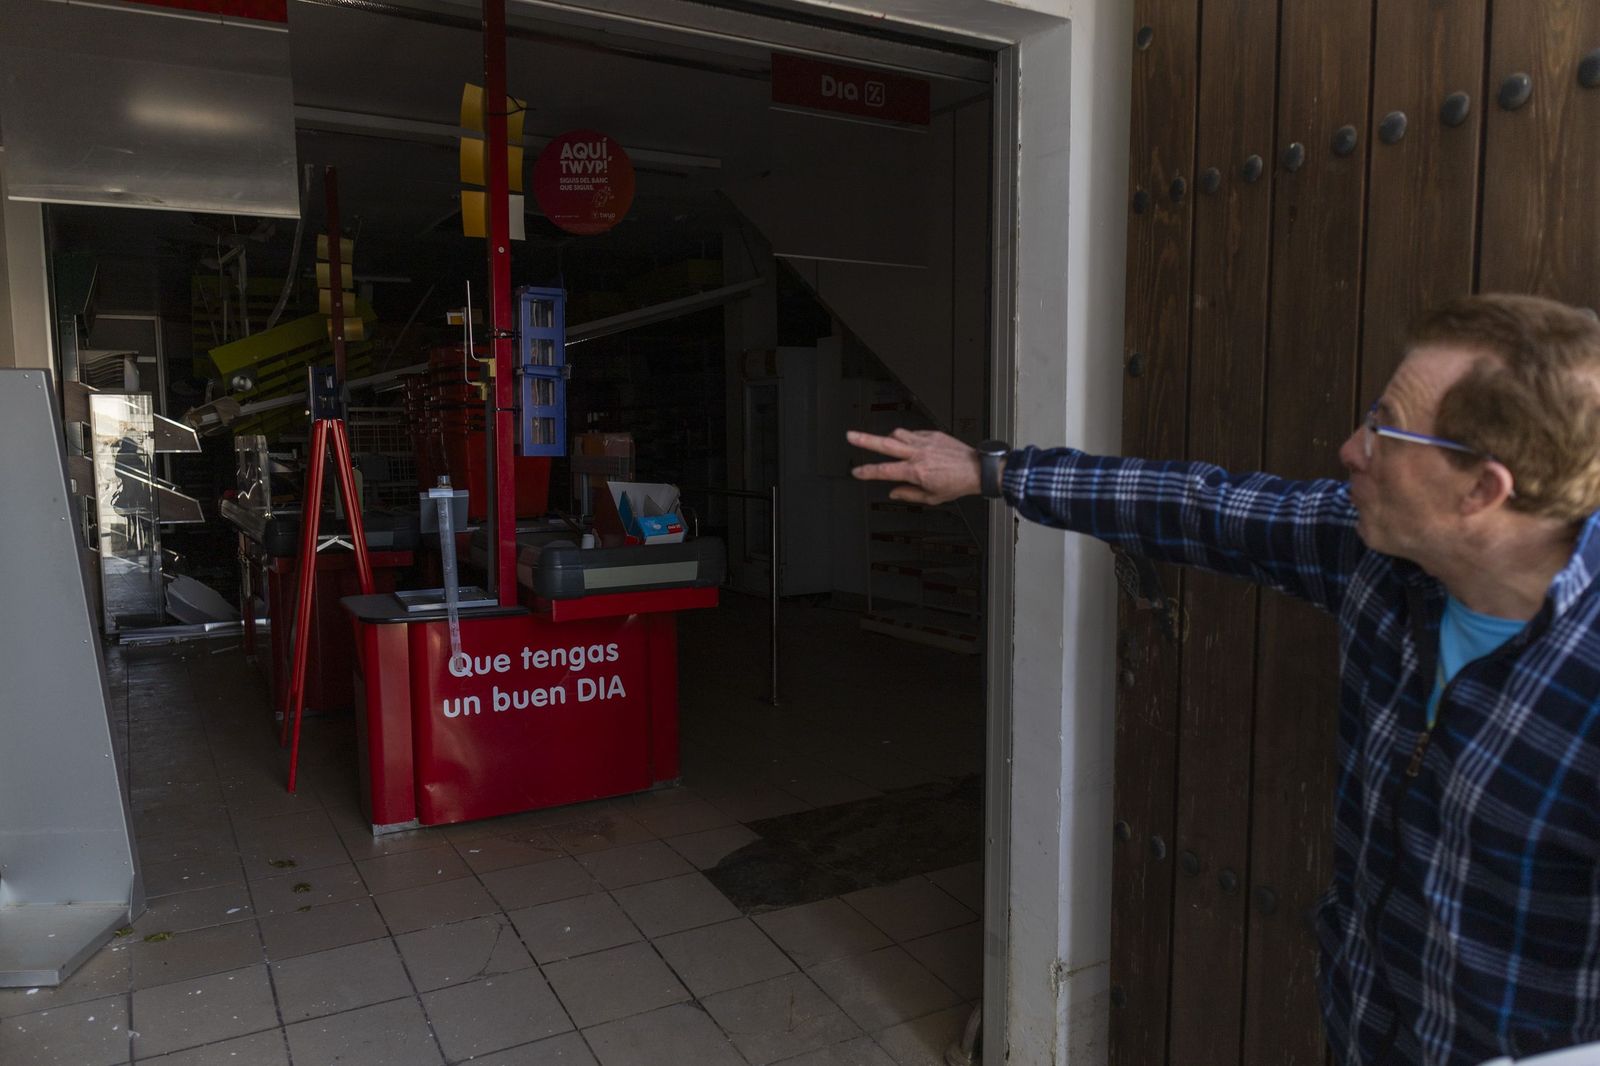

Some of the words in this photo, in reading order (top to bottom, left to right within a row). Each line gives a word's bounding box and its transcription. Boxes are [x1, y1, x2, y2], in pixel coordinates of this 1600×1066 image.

[560, 136, 613, 161] AQUÍ,
[560, 160, 608, 174] TWYP!
[448, 651, 511, 678] Que
[521, 643, 620, 672] tengas
[443, 695, 481, 718] un
[492, 685, 566, 712] buen
[577, 674, 627, 702] DIA
